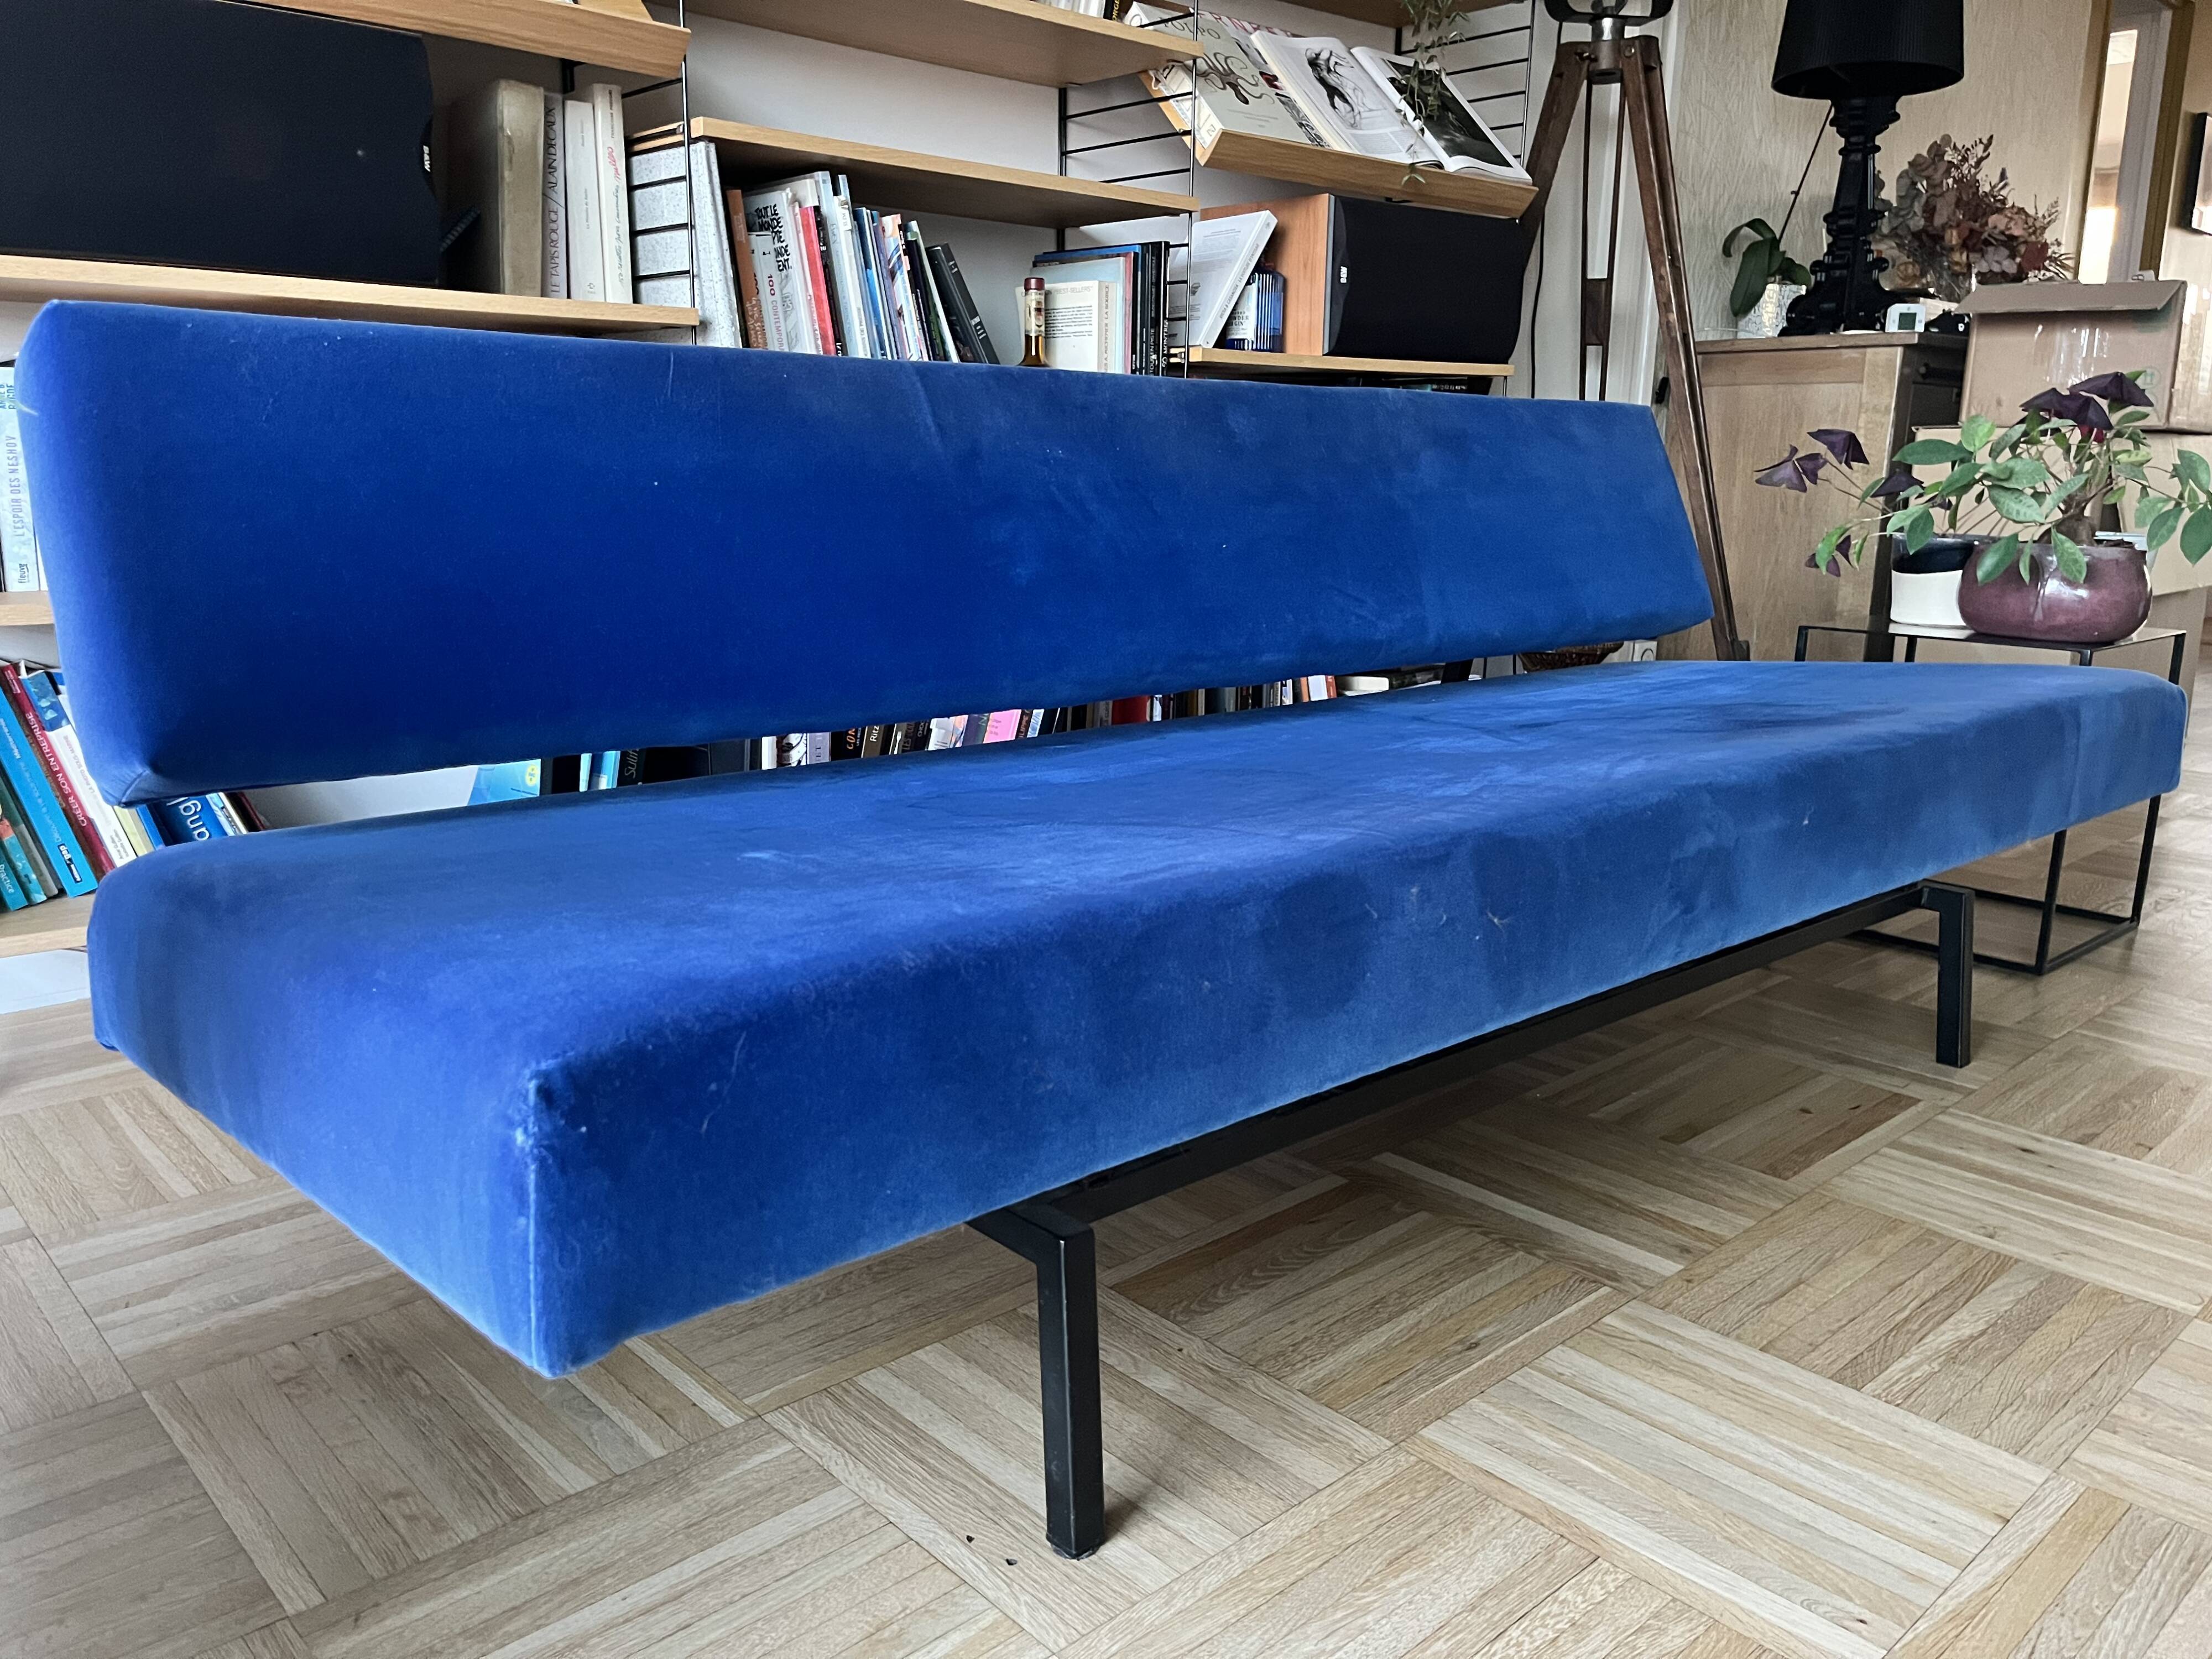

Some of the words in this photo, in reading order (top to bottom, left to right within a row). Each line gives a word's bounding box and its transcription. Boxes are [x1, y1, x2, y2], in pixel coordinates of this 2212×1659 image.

[546, 106, 556, 155] DECAUX
[546, 158, 558, 194] ALAIN
[770, 204, 779, 216] LE
[548, 207, 559, 248] ROUGE
[549, 251, 559, 276] TAPIS
[550, 282, 560, 293] LE
[767, 274, 776, 296] 100
[6, 435, 19, 473] NESHOV
[11, 476, 22, 494] DES
[13, 495, 25, 537] L'ESPOIR
[18, 563, 28, 584] fleuve
[25, 711, 60, 772] ENTREPRISE
[870, 726, 879, 742] Ritz
[55, 773, 71, 795] SON
[66, 795, 88, 827] CRÉER
[59, 843, 72, 860] gap
[0, 863, 15, 894] Practice
